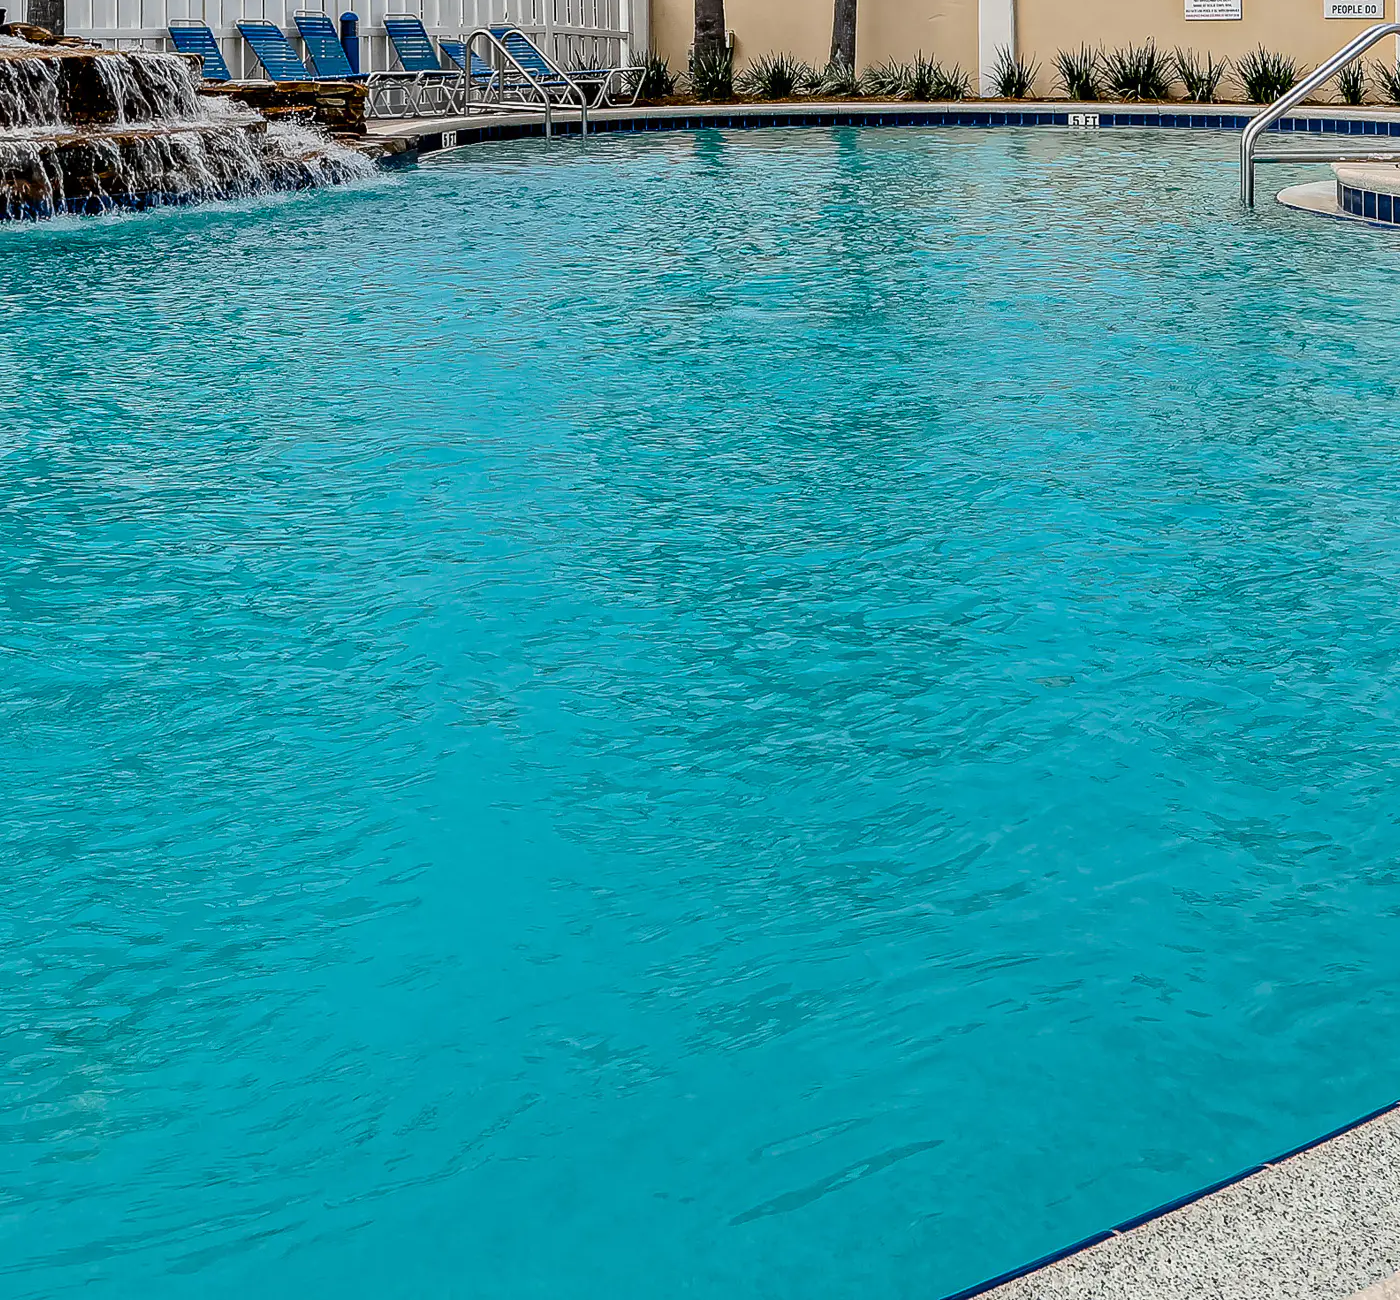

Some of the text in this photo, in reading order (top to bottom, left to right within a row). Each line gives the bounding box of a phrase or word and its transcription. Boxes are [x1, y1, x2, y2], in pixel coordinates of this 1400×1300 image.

[1332, 5, 1377, 14] PEOPLE DO
[1085, 116, 1097, 128] FT
